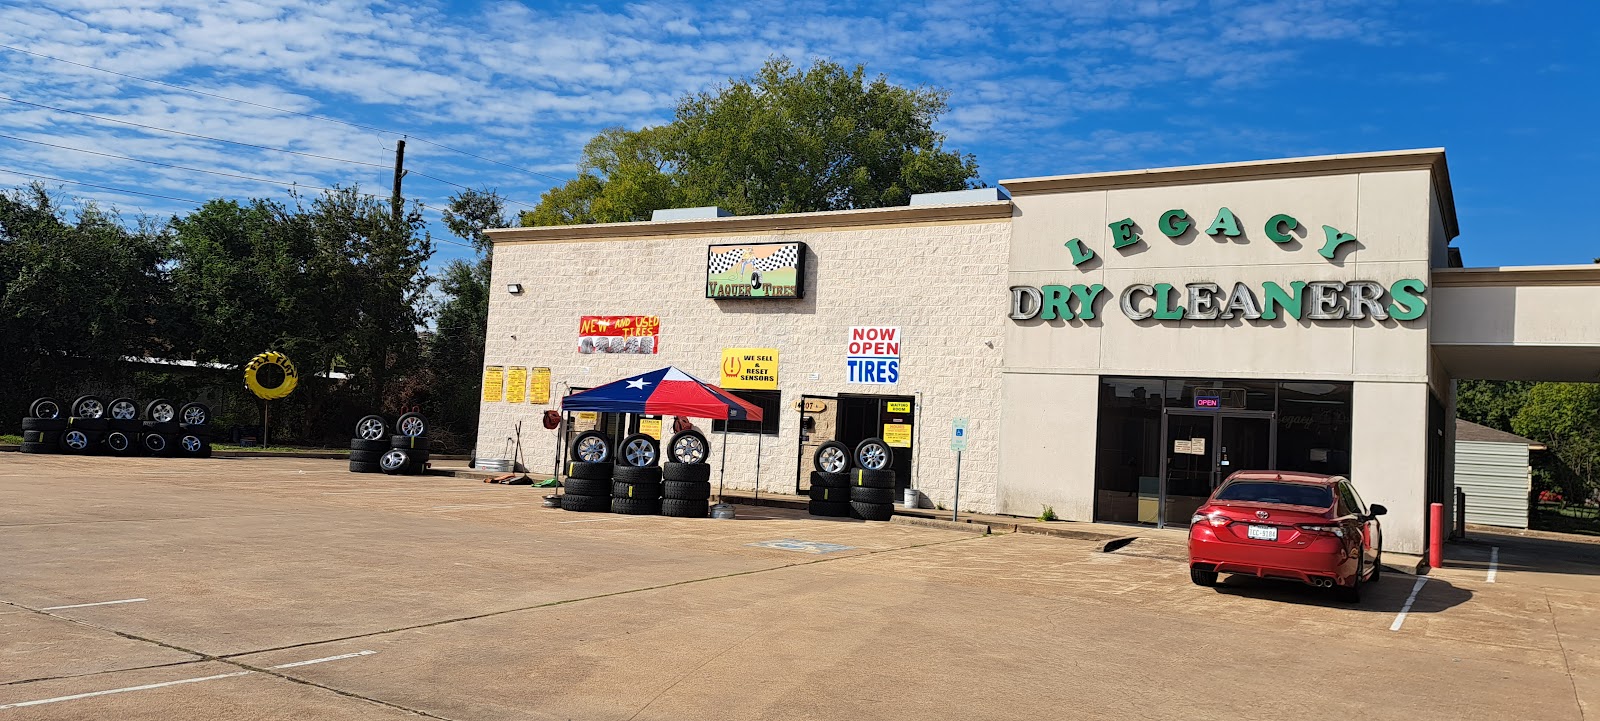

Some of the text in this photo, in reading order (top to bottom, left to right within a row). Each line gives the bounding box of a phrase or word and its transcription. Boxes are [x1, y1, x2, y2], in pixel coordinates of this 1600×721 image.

[1064, 206, 1357, 267] LEGACY
[762, 282, 798, 297] TIRES
[1008, 279, 1427, 321] DRY CLEANERS
[580, 315, 659, 334] NEW AND USED
[622, 327, 655, 341] TIRES
[853, 328, 896, 341] NOW
[848, 342, 899, 355] OPEN
[250, 355, 295, 377] FIX FLAT
[847, 360, 899, 383] TIRES
[1197, 399, 1218, 407] OPEN
